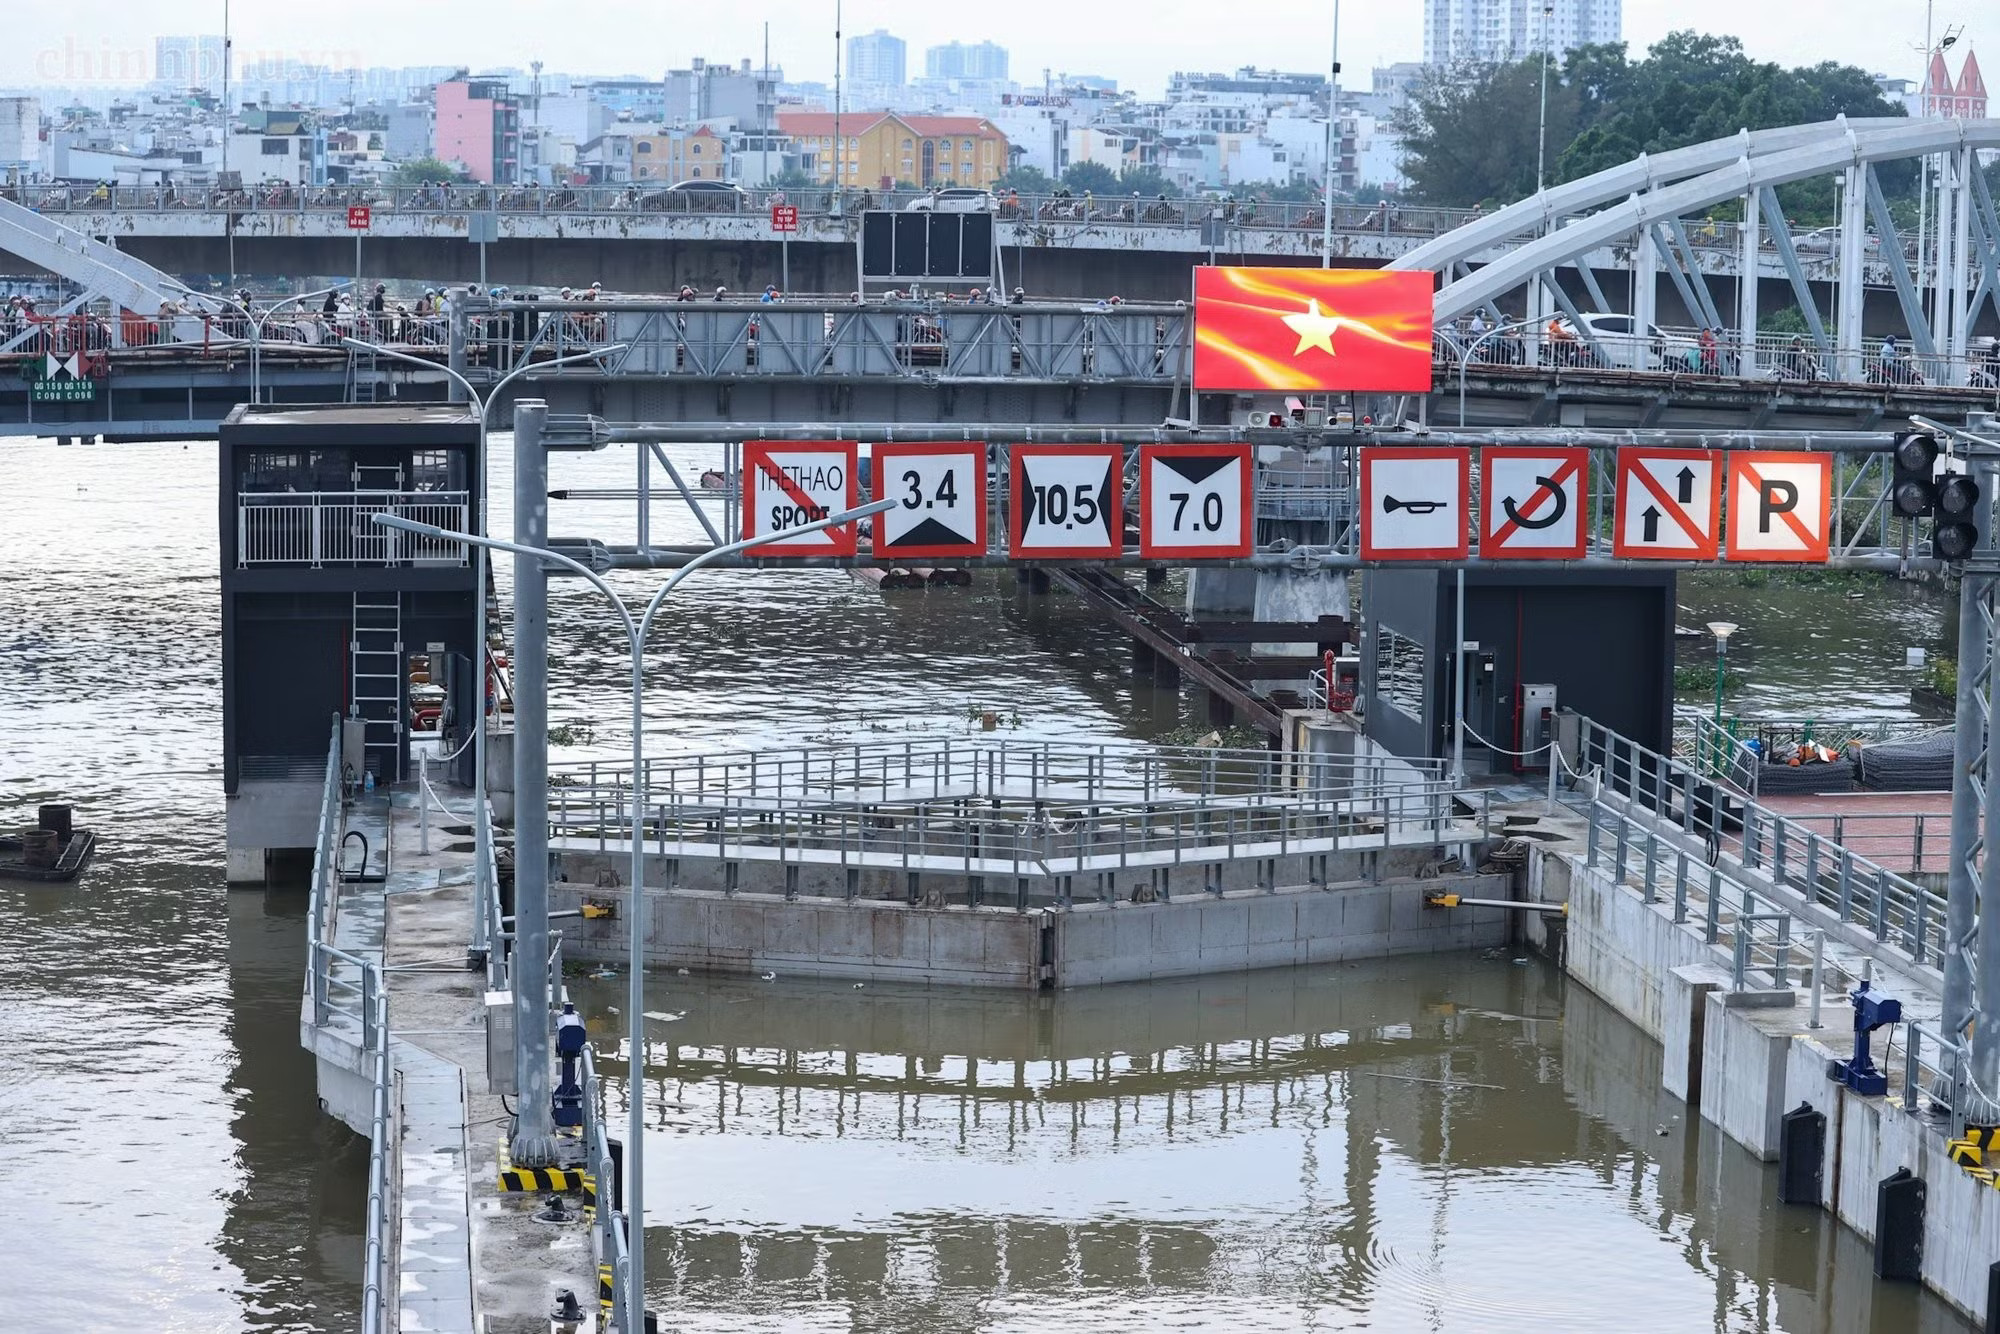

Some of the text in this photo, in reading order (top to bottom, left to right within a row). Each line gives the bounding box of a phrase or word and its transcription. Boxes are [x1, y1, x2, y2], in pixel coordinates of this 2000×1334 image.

[901, 468, 958, 510] 3.4
[1034, 483, 1098, 530] 10.5
[1759, 479, 1799, 533] P
[1169, 491, 1223, 532] 7.0
